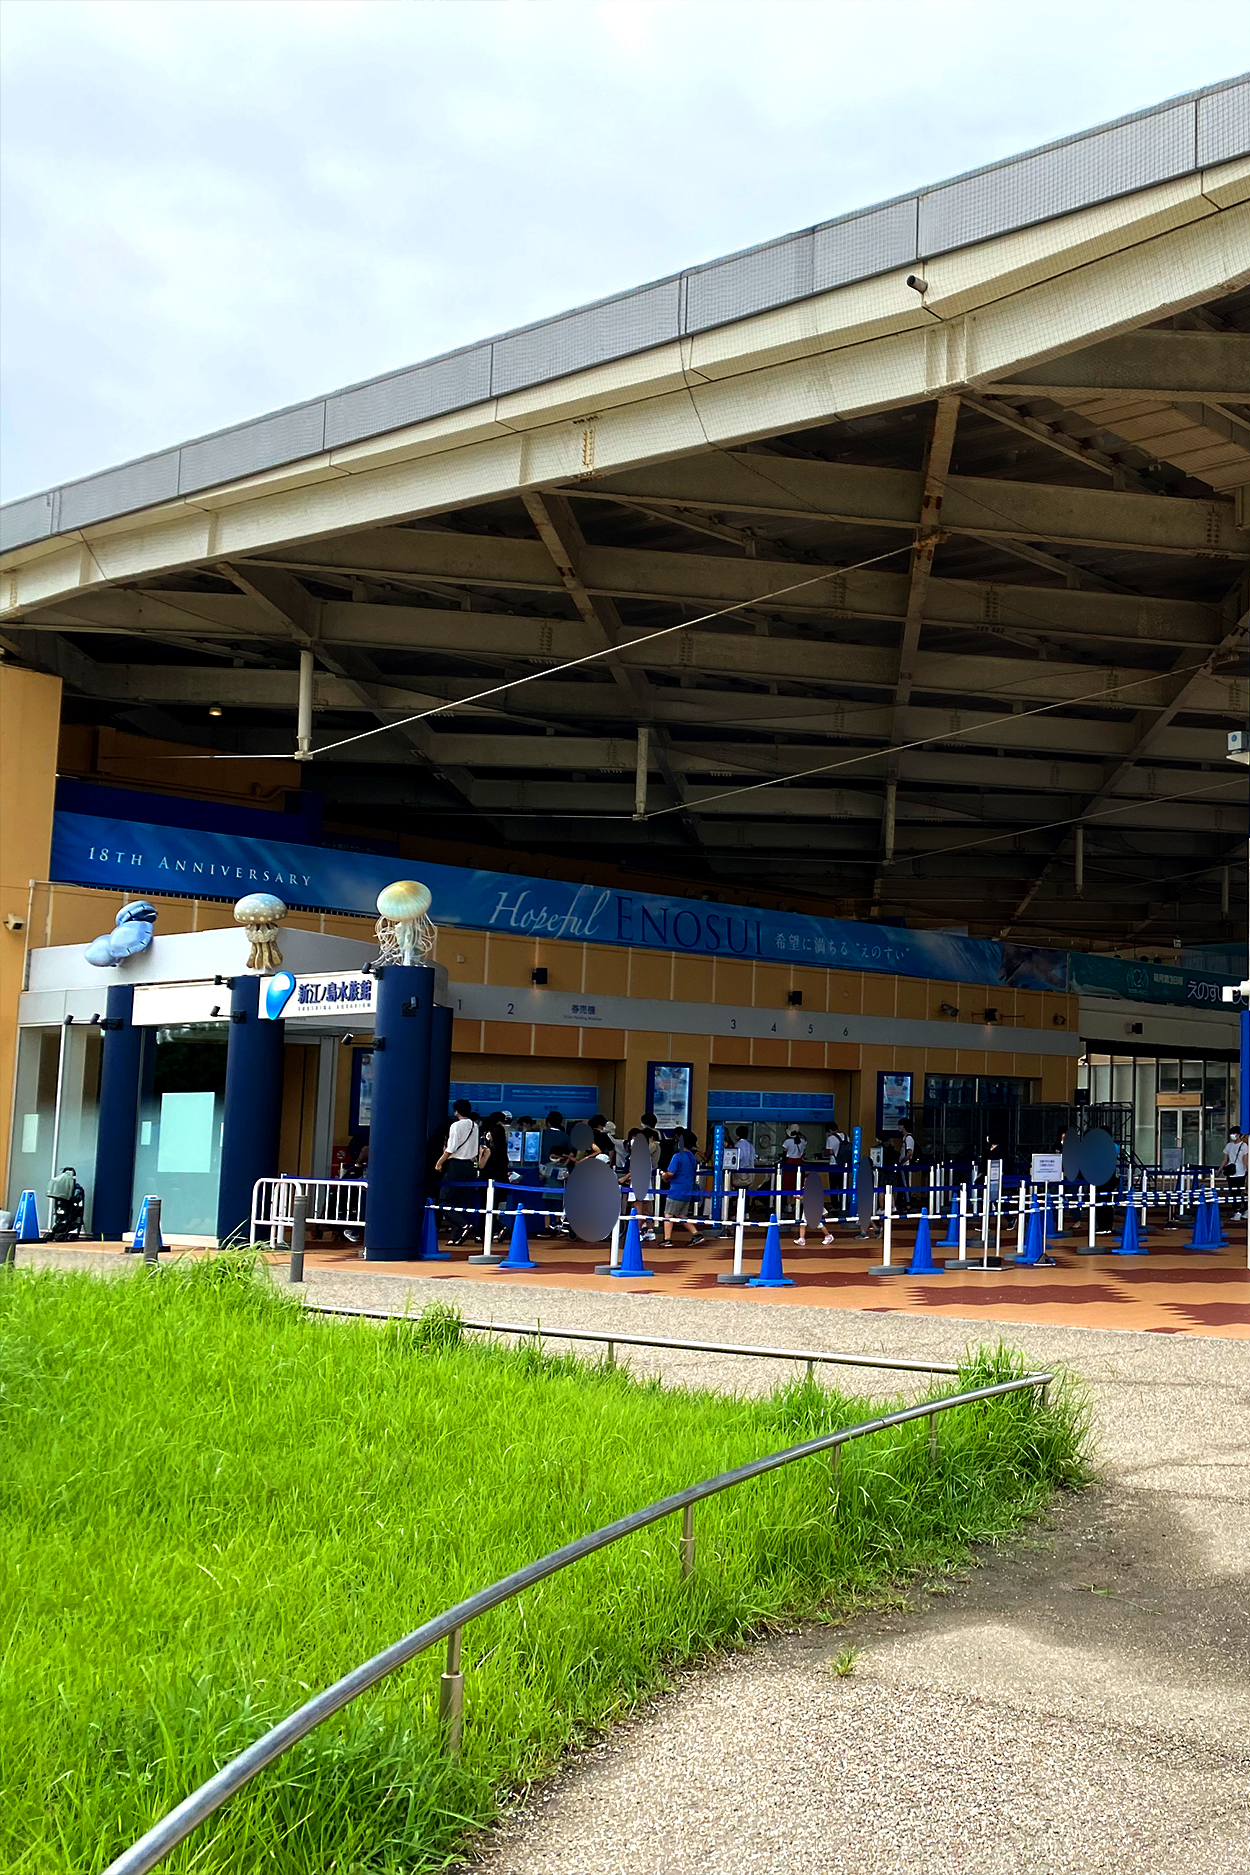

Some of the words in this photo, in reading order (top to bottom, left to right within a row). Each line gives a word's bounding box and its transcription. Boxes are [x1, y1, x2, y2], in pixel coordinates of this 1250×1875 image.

[88, 846, 143, 866] 18TH
[158, 856, 311, 886] ANNIVERSARY
[488, 885, 611, 939] Hopeful
[614, 895, 763, 955] ENOSUI
[774, 932, 848, 956] 希望に満ちる
[297, 979, 372, 1004] 新江ノ島水族館
[458, 999, 462, 1011] 1
[507, 1002, 514, 1015] 2
[730, 1019, 736, 1030] 3
[771, 1022, 777, 1032] 4
[808, 1024, 814, 1034] 5
[843, 1027, 849, 1036] 6
